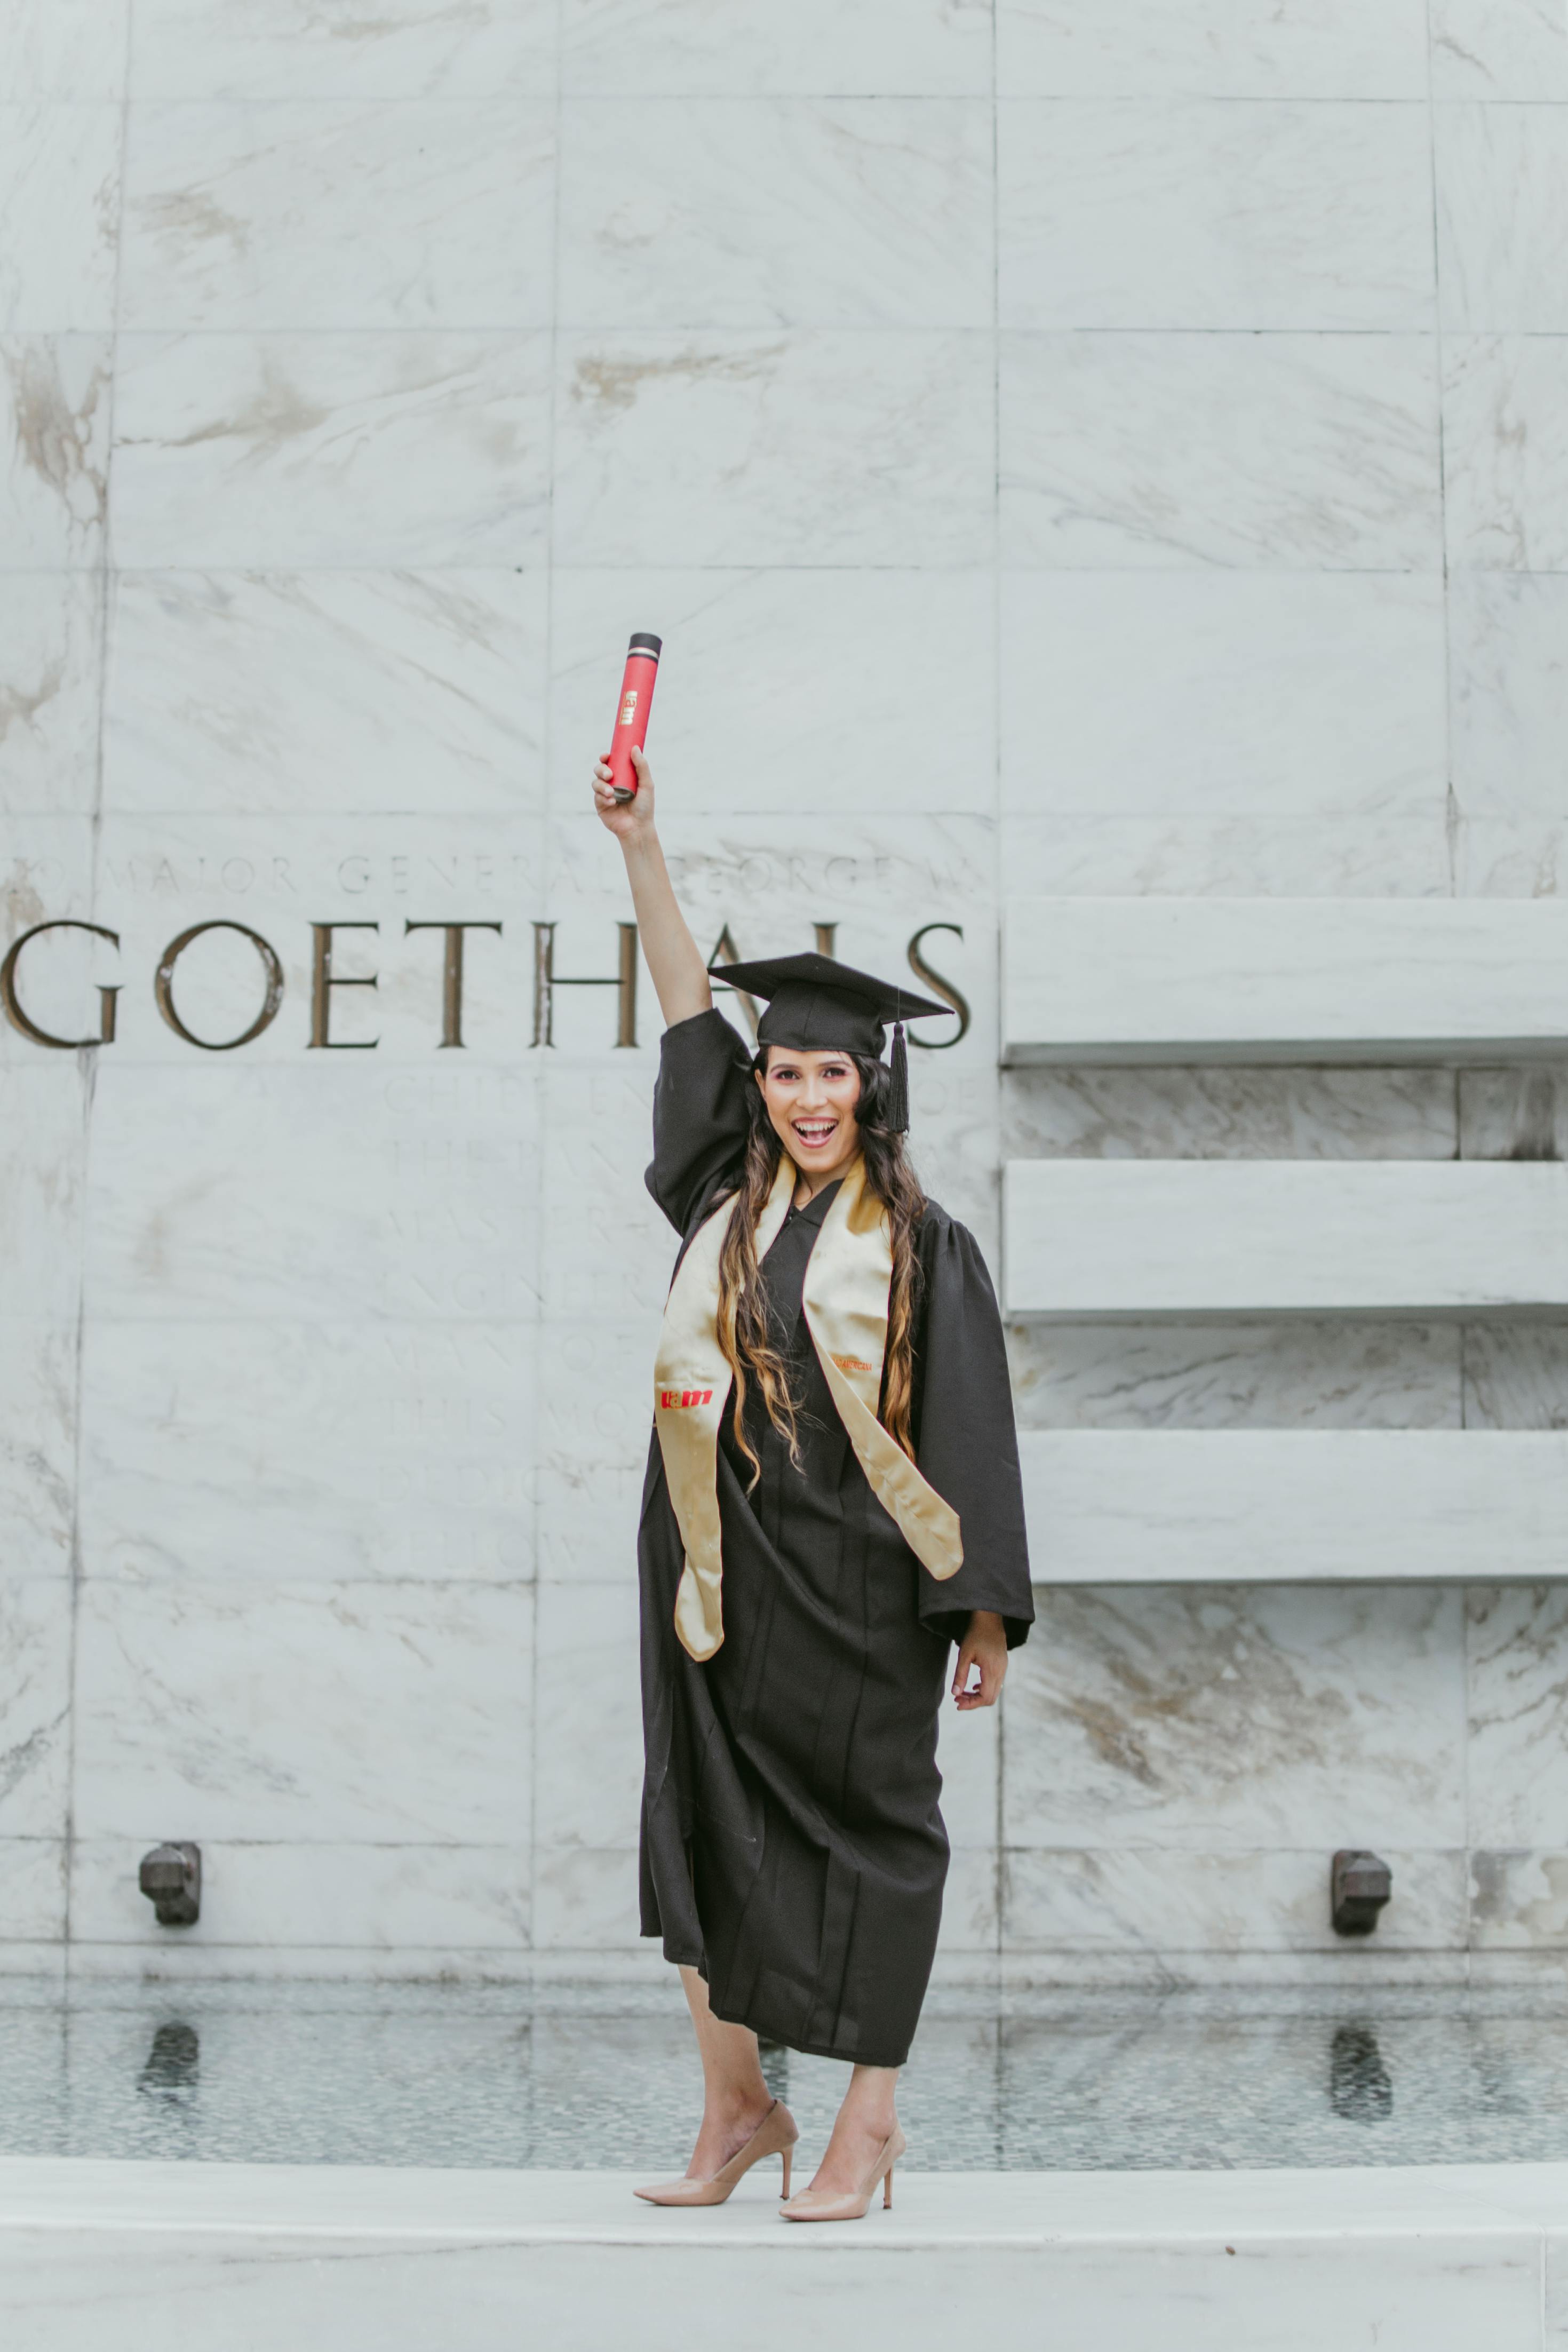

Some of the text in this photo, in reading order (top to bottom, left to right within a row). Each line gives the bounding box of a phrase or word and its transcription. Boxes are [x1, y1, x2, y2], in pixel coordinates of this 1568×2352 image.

[102, 855, 298, 894] MAJOR
[337, 855, 615, 894] GENERAL
[383, 1074, 551, 1116] CHIEF
[378, 1397, 507, 1437] THIS
[661, 1389, 713, 1409] uam
[376, 1464, 639, 1504] DEDICAT
